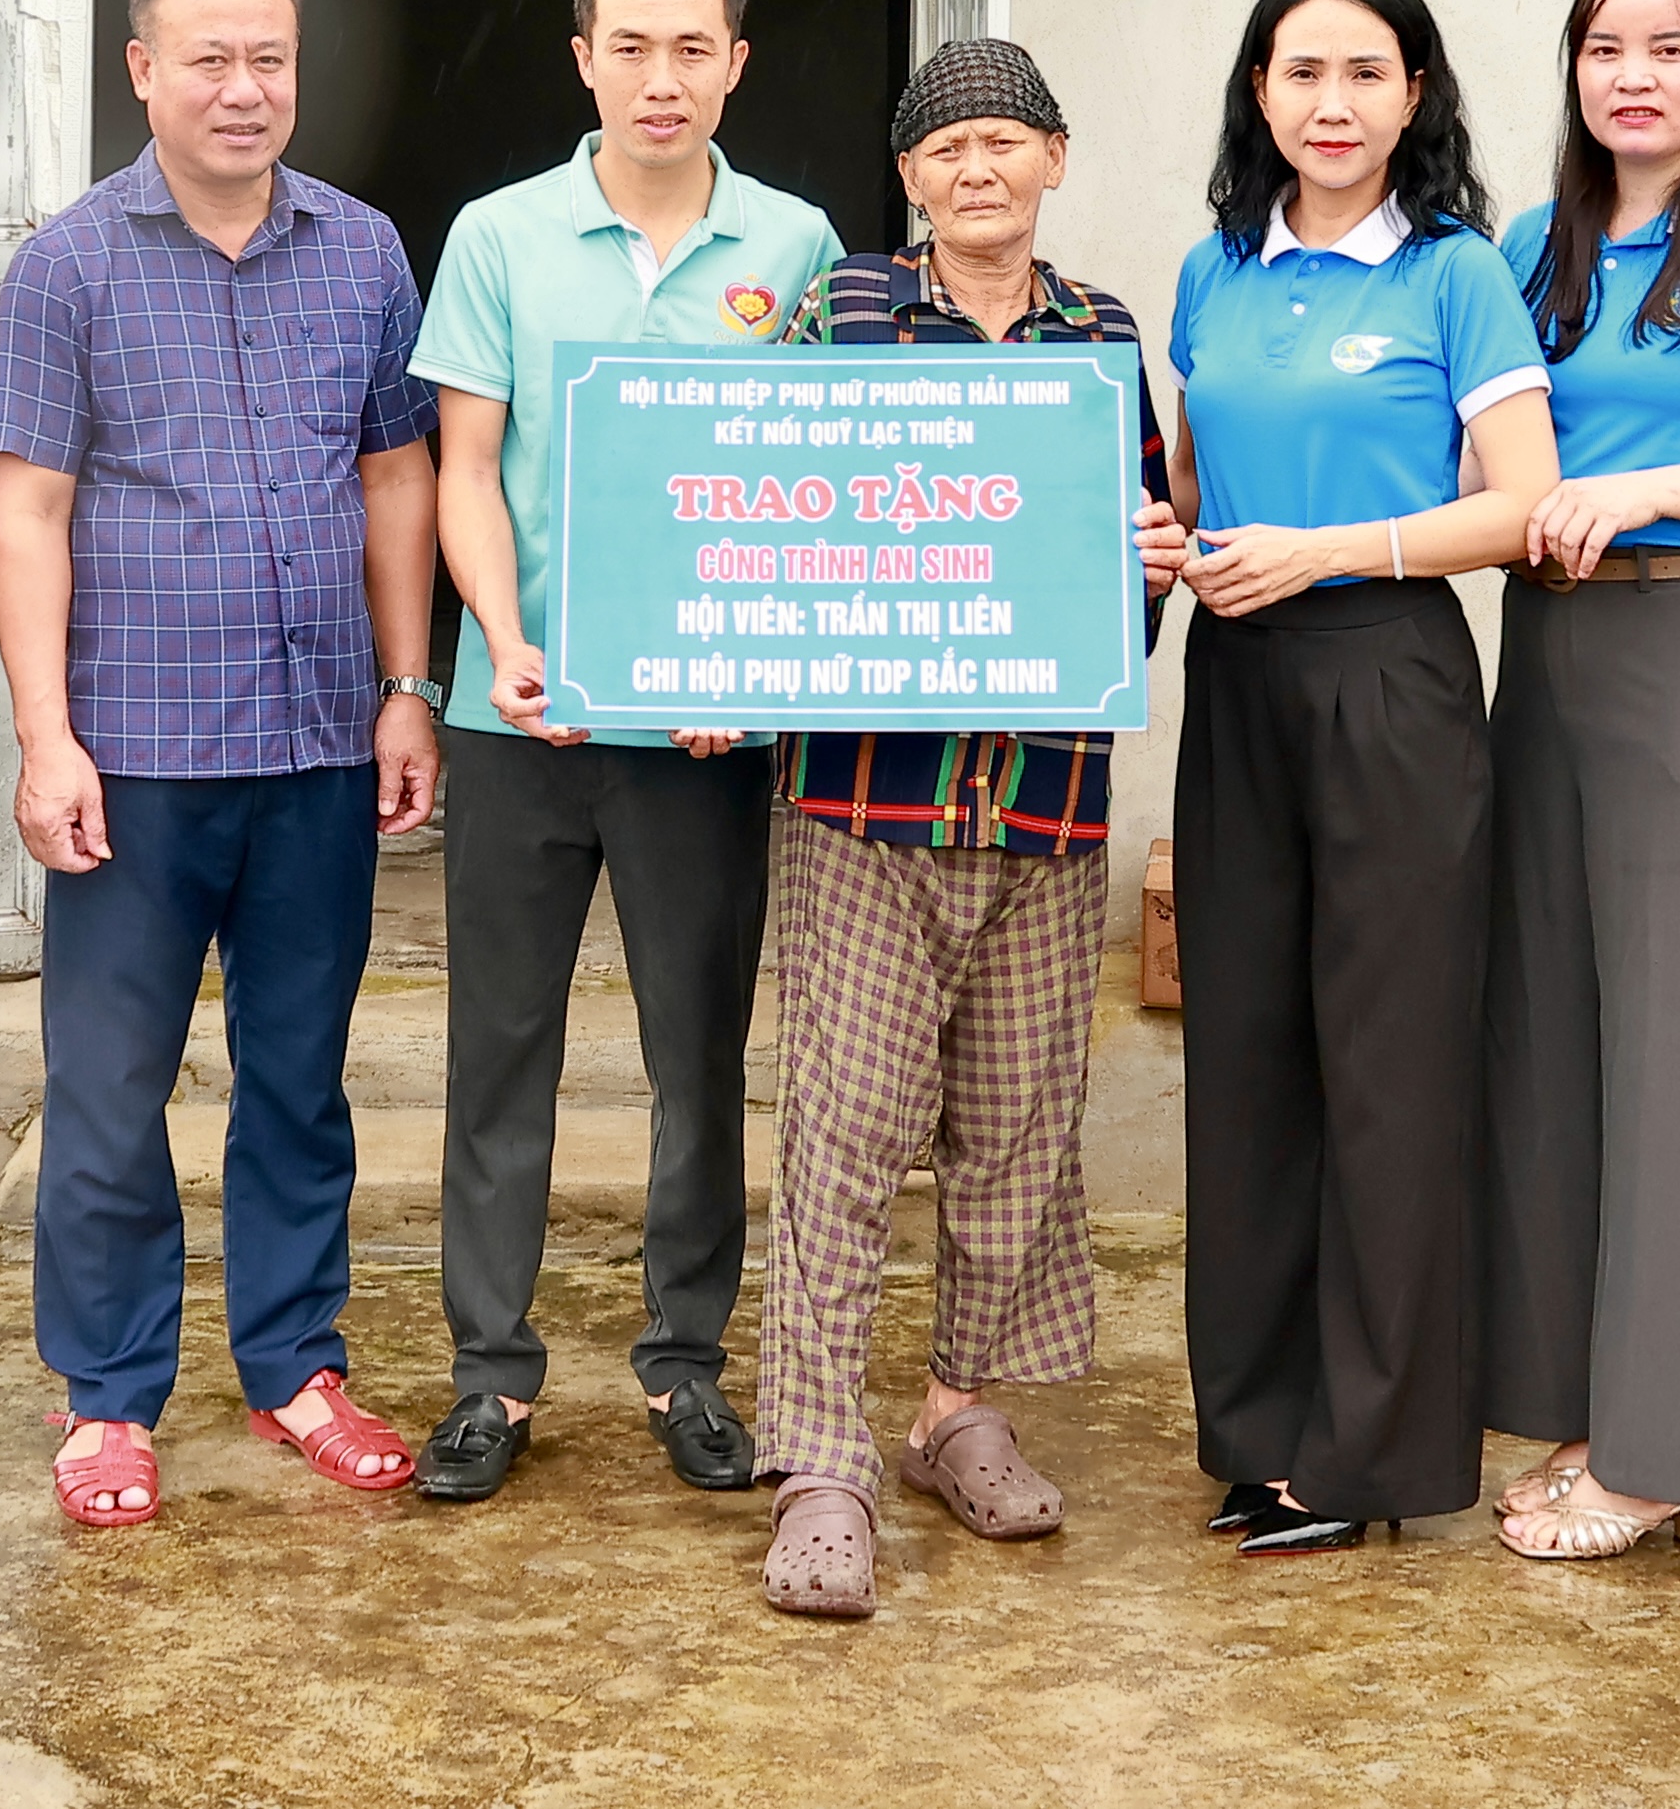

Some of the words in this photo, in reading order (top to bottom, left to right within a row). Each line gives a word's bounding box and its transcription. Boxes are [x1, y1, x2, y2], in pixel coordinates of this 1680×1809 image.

[620, 377, 658, 409] HỘI
[664, 378, 715, 405] LIÊN
[721, 378, 772, 411] HIỆP
[779, 383, 824, 411] PHỤ
[831, 379, 865, 406] NỮ
[869, 378, 962, 406] PHƯỜNG
[968, 374, 1007, 405] HẢI
[1013, 381, 1070, 405] NINH
[715, 414, 757, 445] KẾT
[762, 414, 802, 445] NỐI
[808, 417, 853, 447] QUỸ
[859, 421, 902, 450] LẠC
[907, 416, 974, 449] THIỆN
[668, 476, 836, 522] TRAO
[849, 463, 1022, 532] TẶNG
[697, 538, 776, 582] CÔNG
[782, 539, 867, 582] TRÌNH
[873, 545, 916, 582] AN
[922, 544, 993, 582] SINH
[677, 594, 724, 642] HỘI
[732, 595, 806, 635] VIÊN:
[814, 590, 888, 635] TRẦN
[896, 601, 940, 643] THỊ
[949, 595, 1012, 635] LIÊN
[632, 657, 680, 693] CHI
[688, 653, 736, 701] HỘI
[744, 659, 801, 701] PHỤ
[810, 653, 853, 694] NỮ
[857, 659, 912, 694] TDP
[920, 647, 977, 694] BẮC
[986, 659, 1057, 694] NINH
